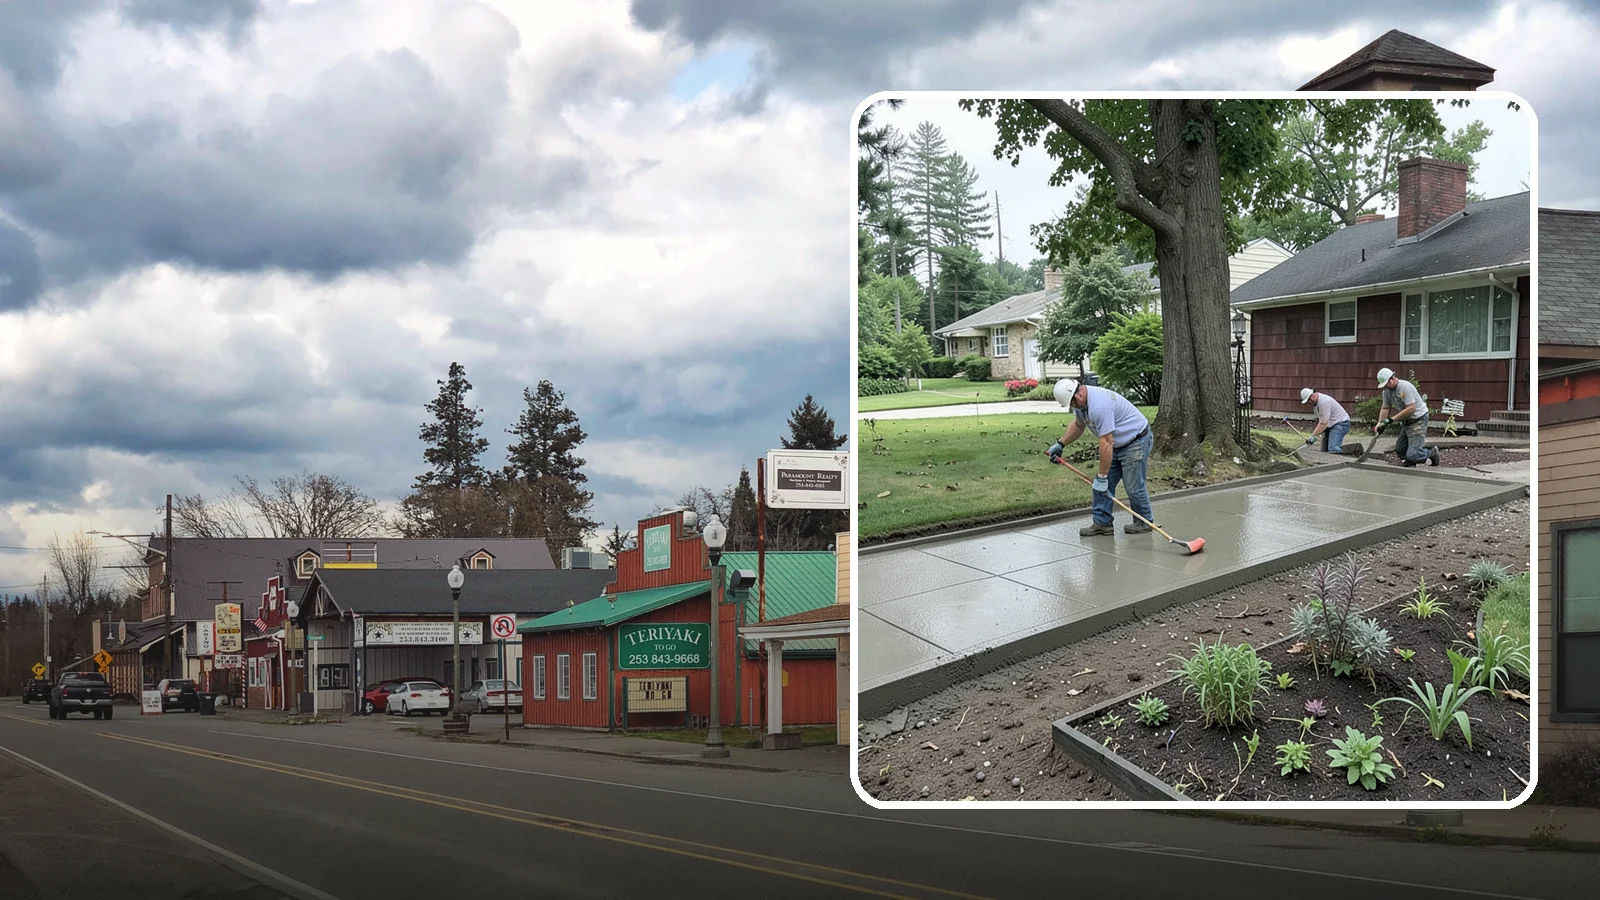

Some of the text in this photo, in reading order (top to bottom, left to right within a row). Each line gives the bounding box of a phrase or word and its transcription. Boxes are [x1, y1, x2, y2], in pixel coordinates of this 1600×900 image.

[817, 472, 839, 480] REALTY
[625, 627, 702, 646] TERIYAKI
[629, 653, 700, 665] 253 843-9668
